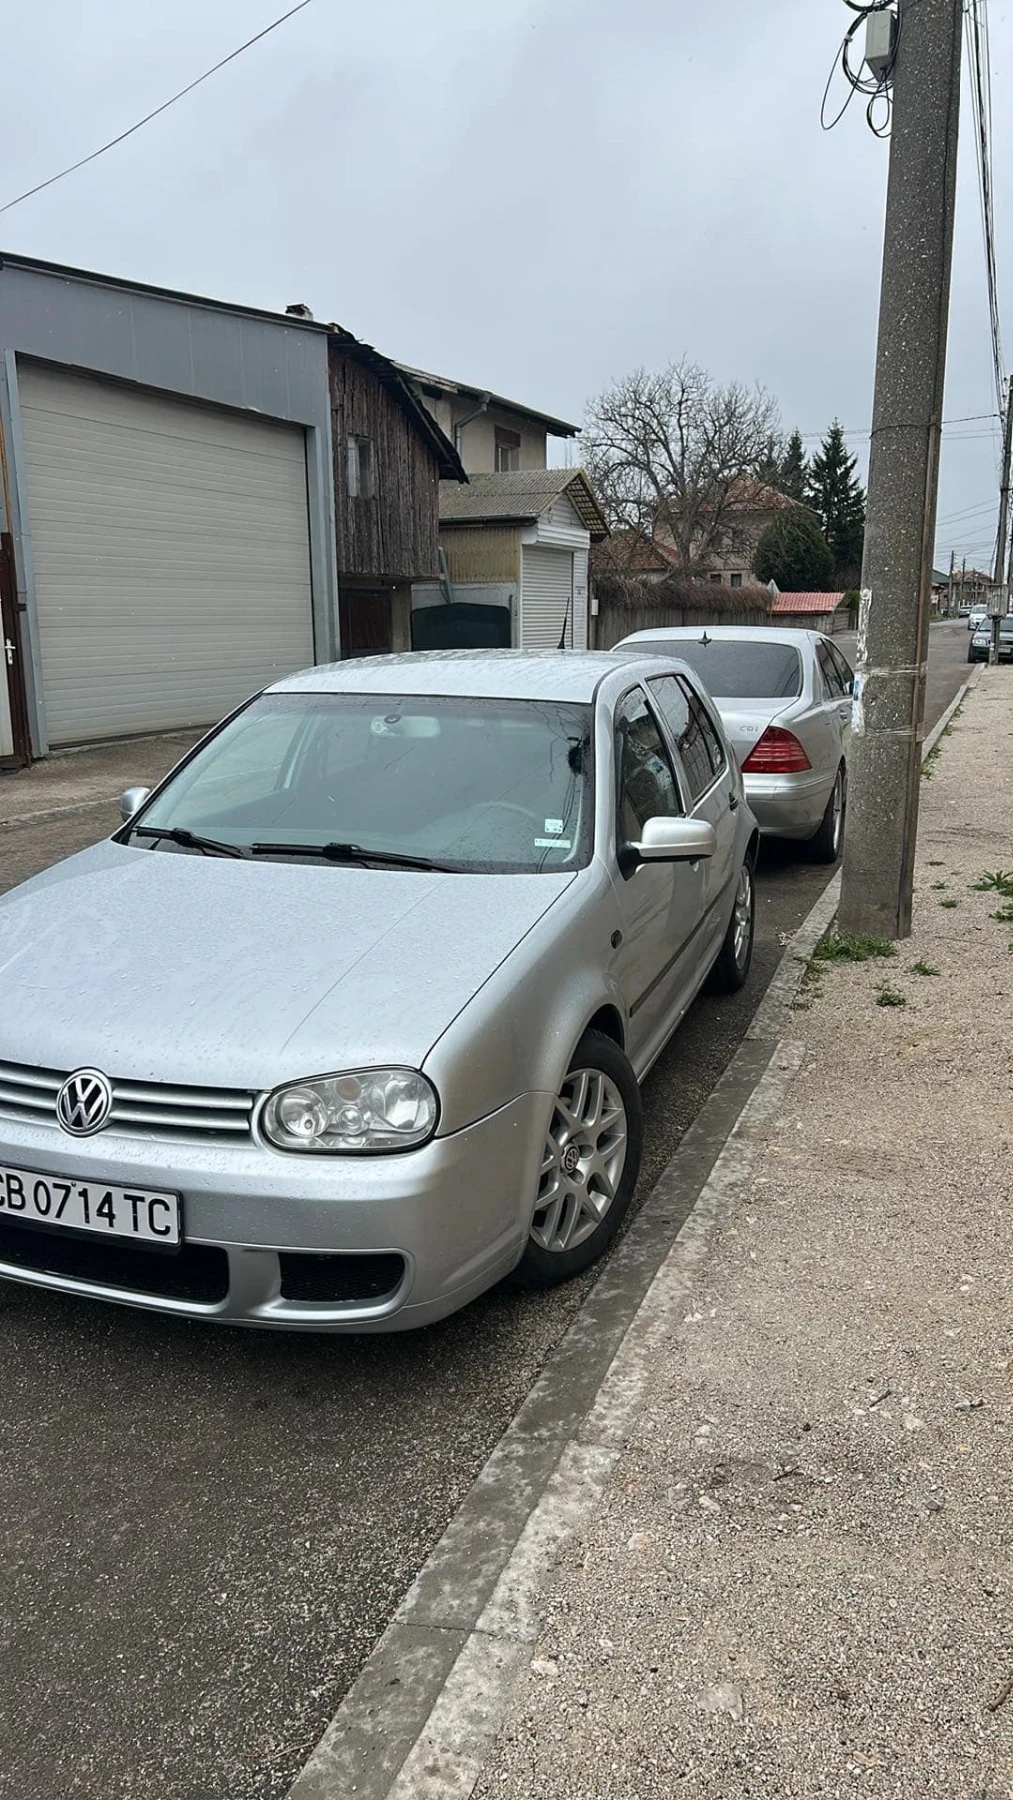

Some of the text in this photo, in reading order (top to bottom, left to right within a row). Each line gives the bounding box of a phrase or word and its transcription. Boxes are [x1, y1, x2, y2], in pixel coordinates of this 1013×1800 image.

[59, 1074, 109, 1131] VW
[33, 1180, 116, 1228] 0714
[123, 1194, 171, 1236] TC
